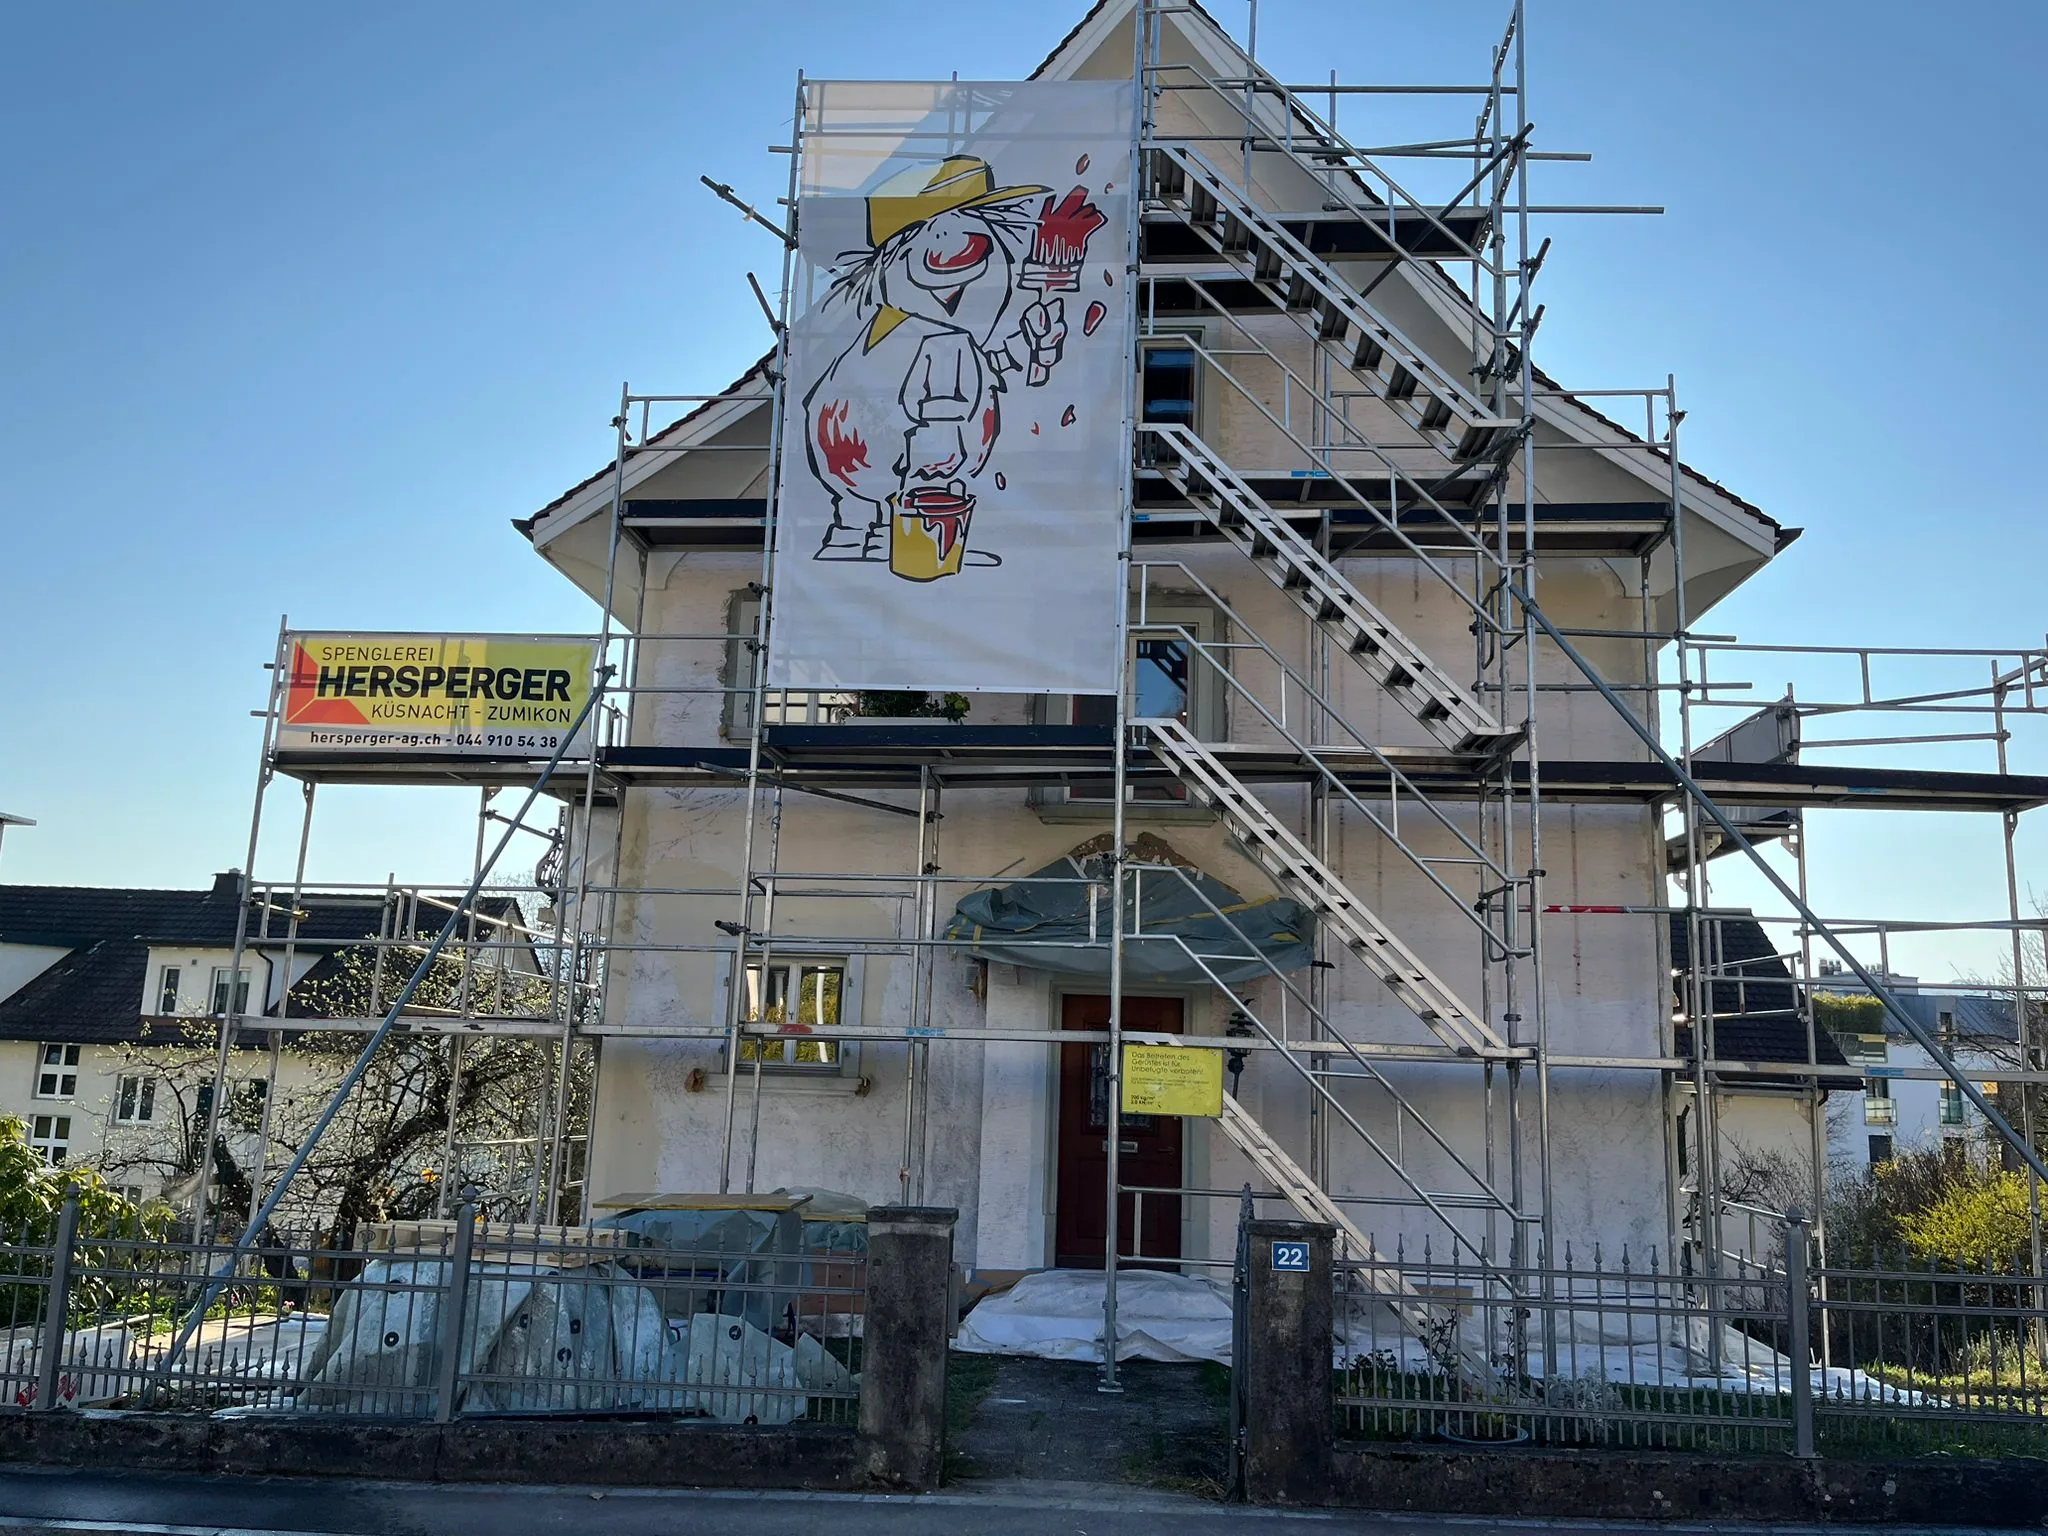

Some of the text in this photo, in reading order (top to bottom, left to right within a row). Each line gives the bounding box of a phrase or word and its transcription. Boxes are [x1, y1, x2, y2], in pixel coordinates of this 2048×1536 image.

[321, 646, 434, 661] SPENGLEREI
[317, 665, 571, 702] HERSPERGER
[371, 700, 469, 719] KÜSNACHT
[487, 705, 571, 723] ZUMIKON
[310, 731, 441, 746] hersperger-ag.ch
[456, 733, 482, 746] 044
[487, 734, 513, 746] 910
[517, 735, 536, 747] 54
[539, 736, 558, 748] 38
[1131, 1051, 1145, 1059] Das
[1146, 1052, 1176, 1060] Betreten
[1131, 1065, 1168, 1074] Unbefugte
[1278, 1247, 1303, 1265] 22
